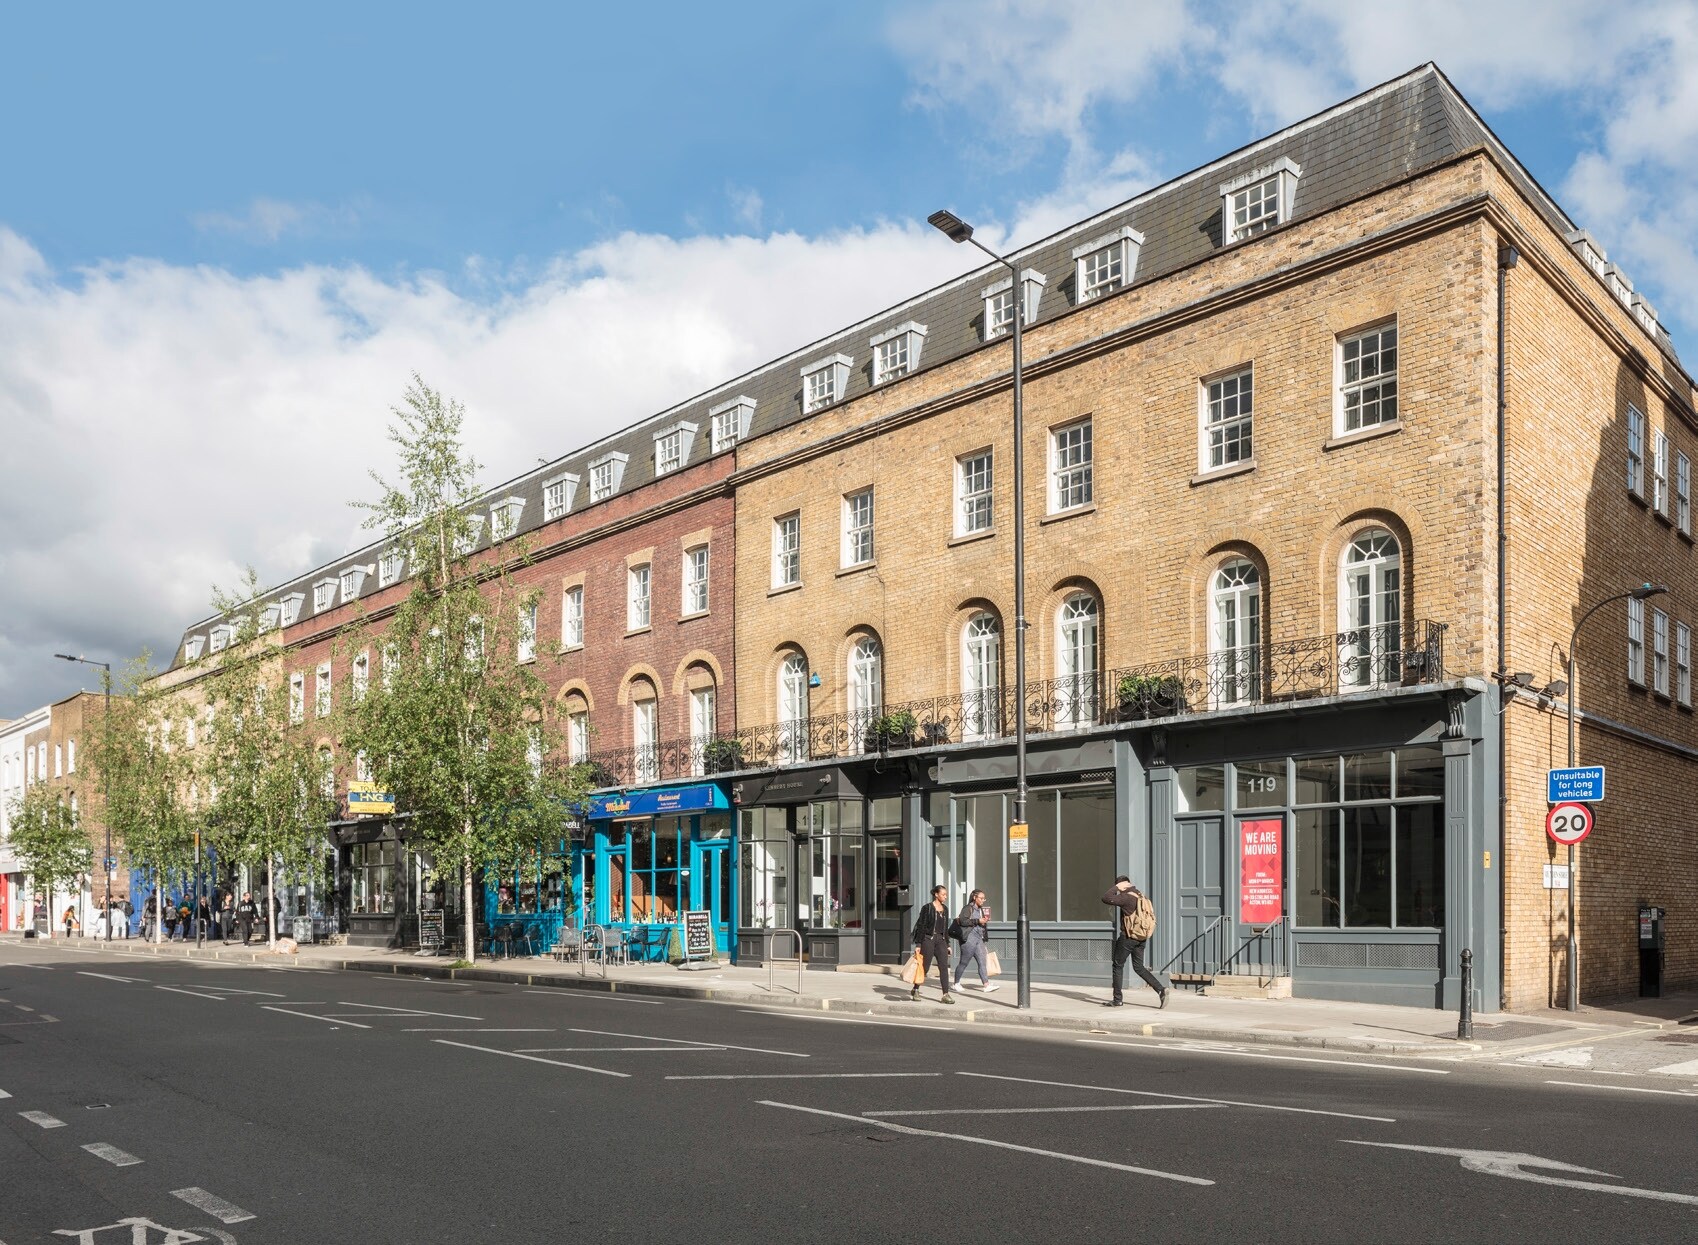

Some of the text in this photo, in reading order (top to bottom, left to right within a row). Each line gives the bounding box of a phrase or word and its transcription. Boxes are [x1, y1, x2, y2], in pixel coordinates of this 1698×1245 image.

[1553, 771, 1600, 780] Unsuitable
[1247, 777, 1276, 793] 119
[1558, 780, 1593, 789] for long
[360, 793, 384, 802] HNG
[1558, 789, 1593, 798] vehicles
[802, 814, 818, 826] 15
[1554, 814, 1586, 833] 20
[1246, 831, 1277, 843] WE ARE
[1245, 843, 1277, 856] MOVING
